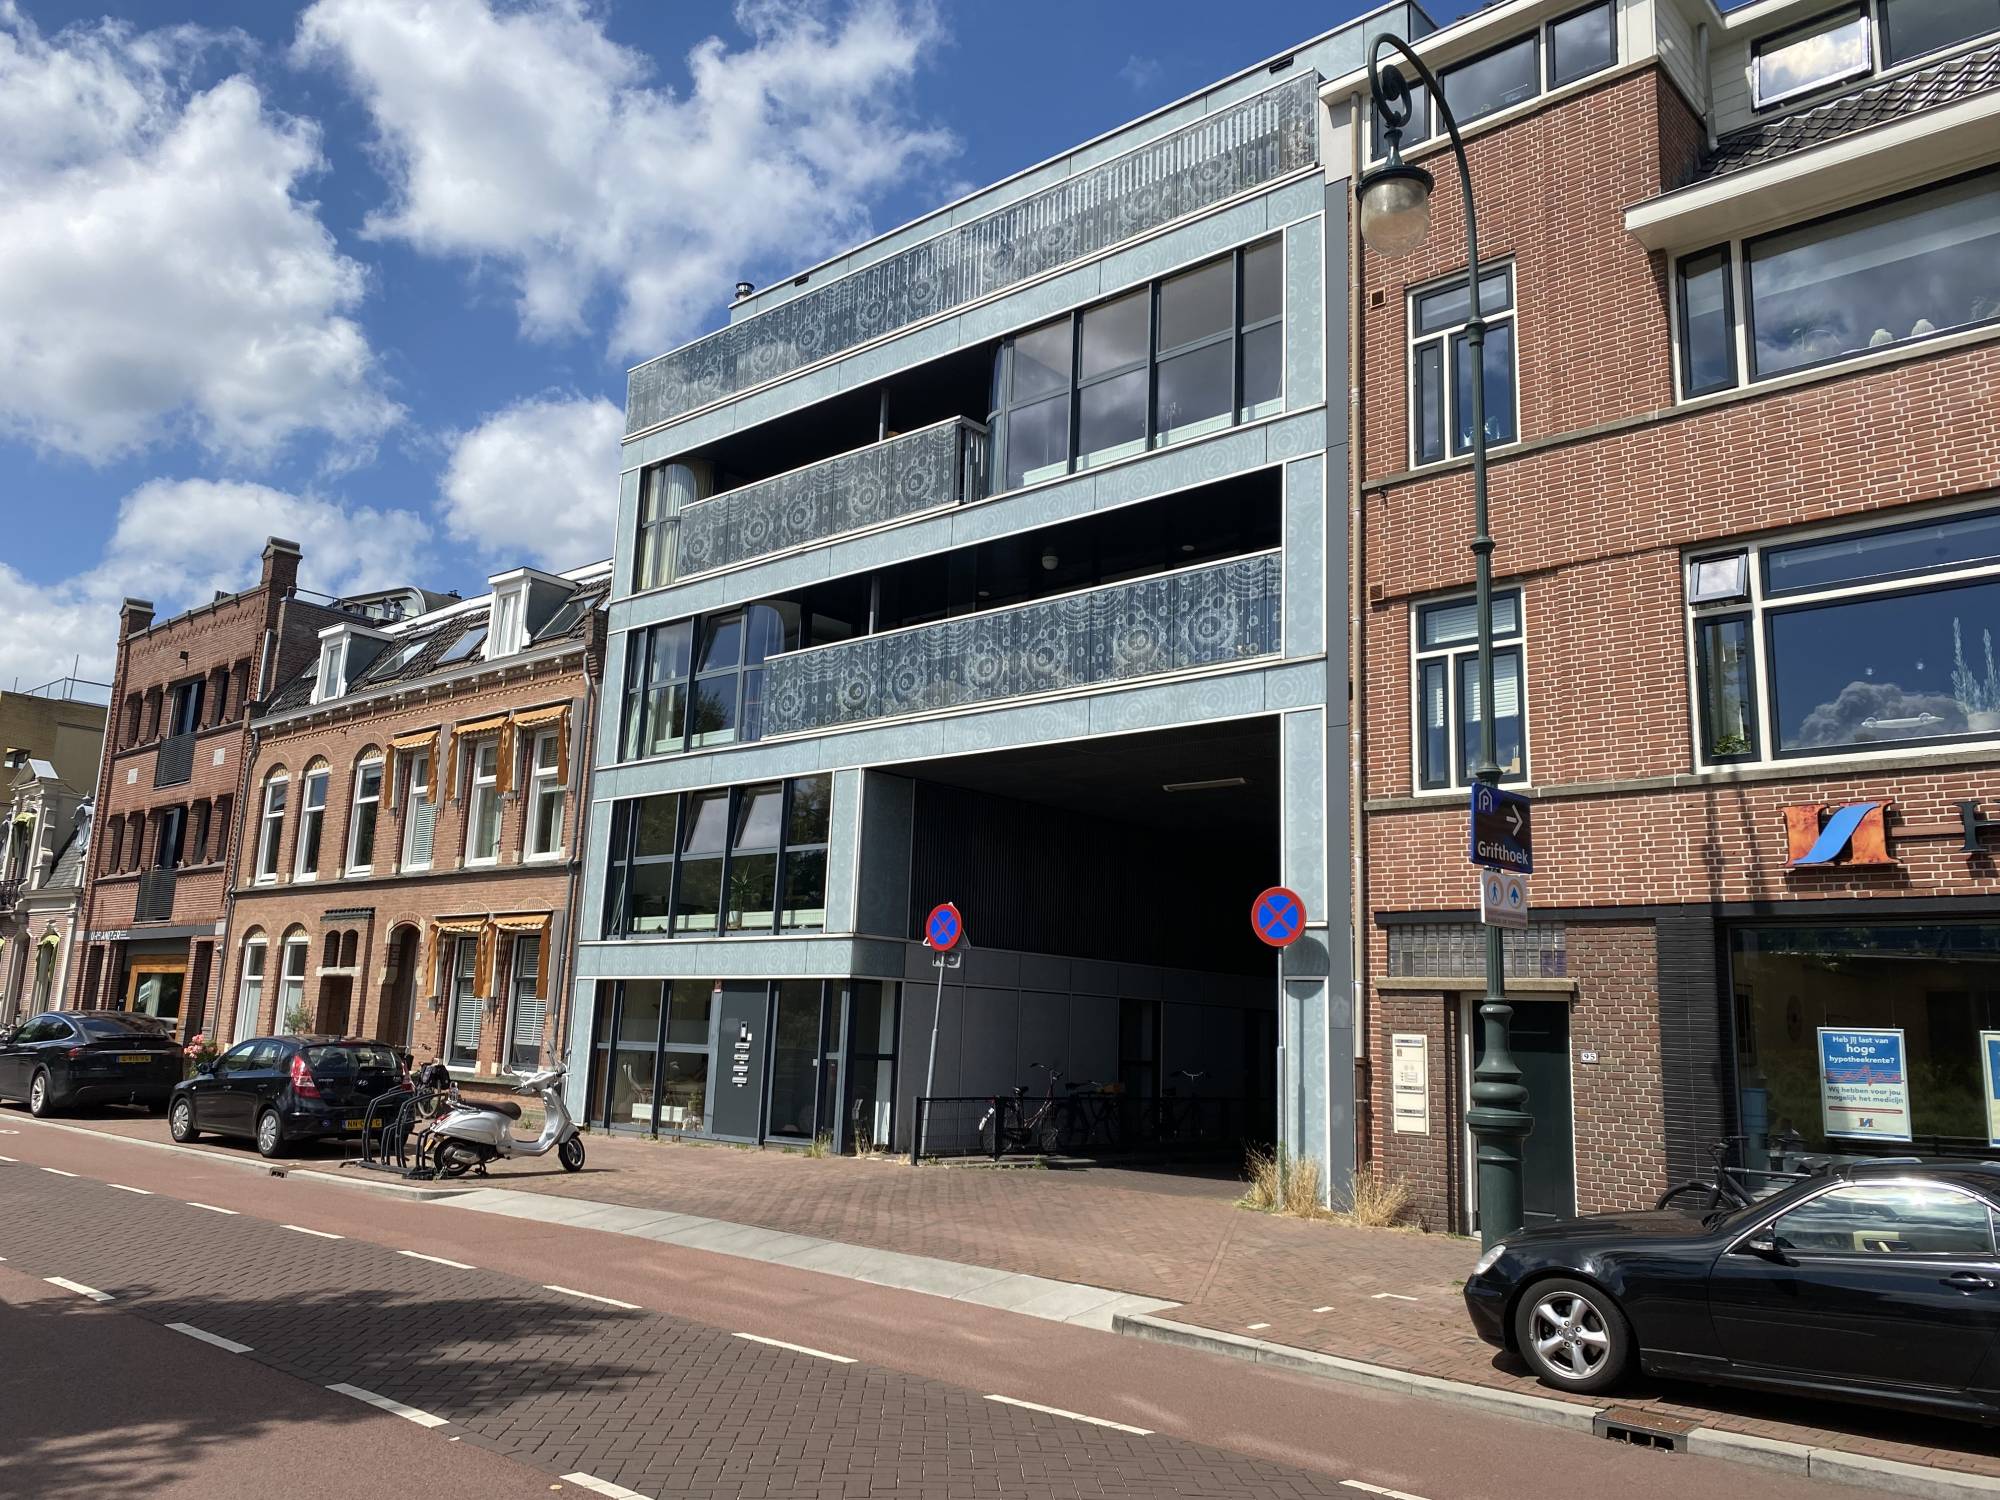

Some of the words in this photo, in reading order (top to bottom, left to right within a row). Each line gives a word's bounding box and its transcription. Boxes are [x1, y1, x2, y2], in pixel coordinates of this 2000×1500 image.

[1482, 795, 1490, 811] P
[1477, 840, 1529, 865] Grifthoek
[1846, 1043, 1876, 1056] hoge
[1829, 1055, 1895, 1064] hypotheekrente?
[1828, 1086, 1840, 1094] Wij
[1827, 1095, 1857, 1103] mogelijk
[1872, 1096, 1904, 1104] medicijn
